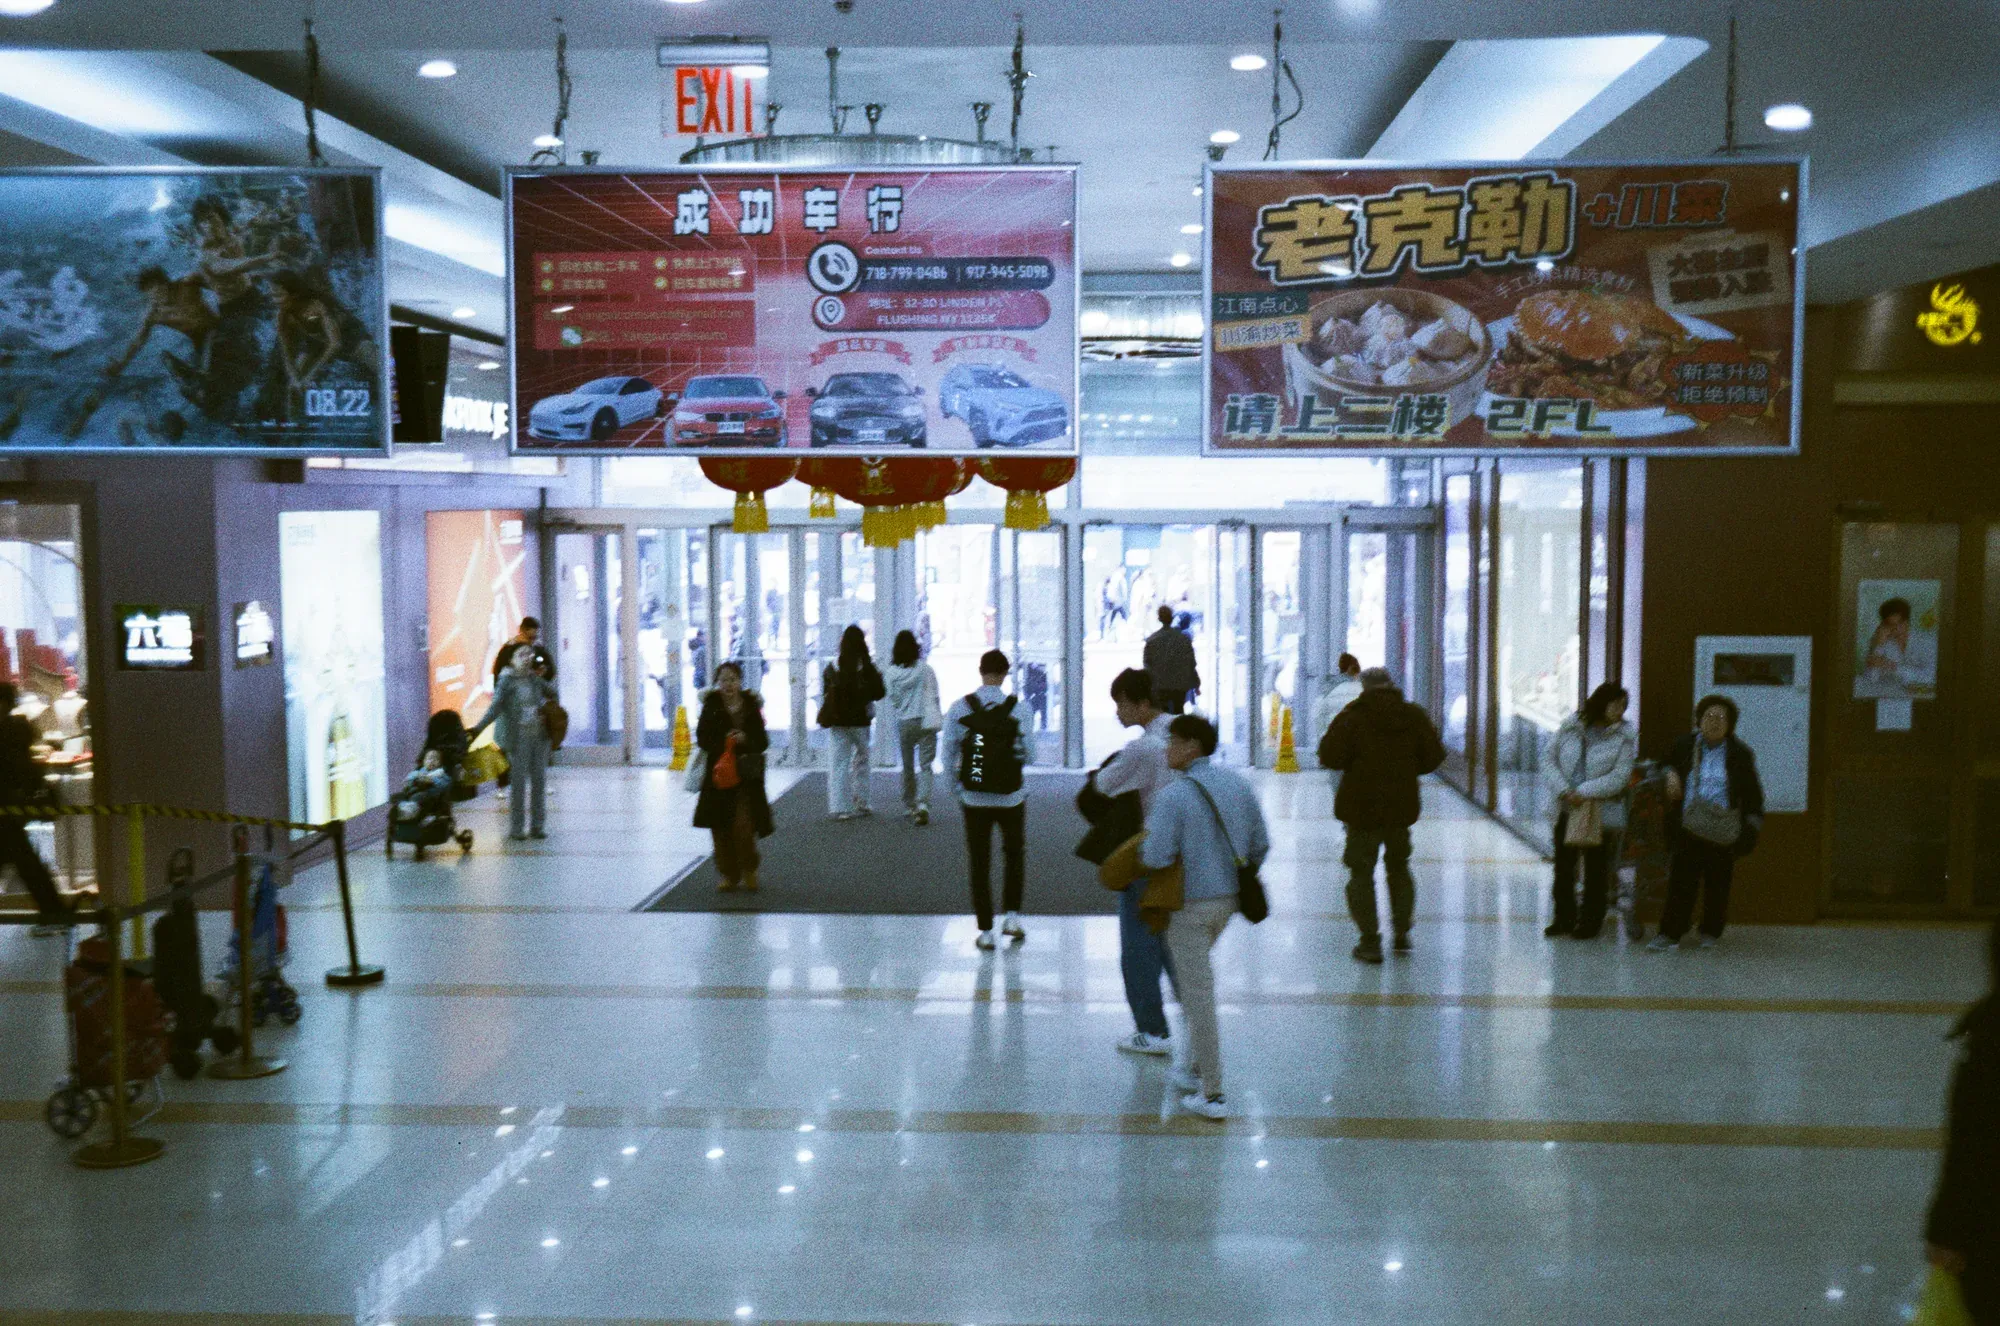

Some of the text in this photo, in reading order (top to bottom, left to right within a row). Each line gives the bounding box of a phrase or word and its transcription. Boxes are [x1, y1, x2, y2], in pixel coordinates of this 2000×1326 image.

[675, 67, 753, 133] EXIT
[673, 185, 902, 235] 成功车行
[1254, 173, 1576, 284] 老克勒
[965, 264, 1049, 279] 917-945-5098
[1218, 296, 1299, 314] 江南点心
[305, 388, 371, 416] 08.22
[1224, 394, 1614, 440] 请上二楼 2FL
